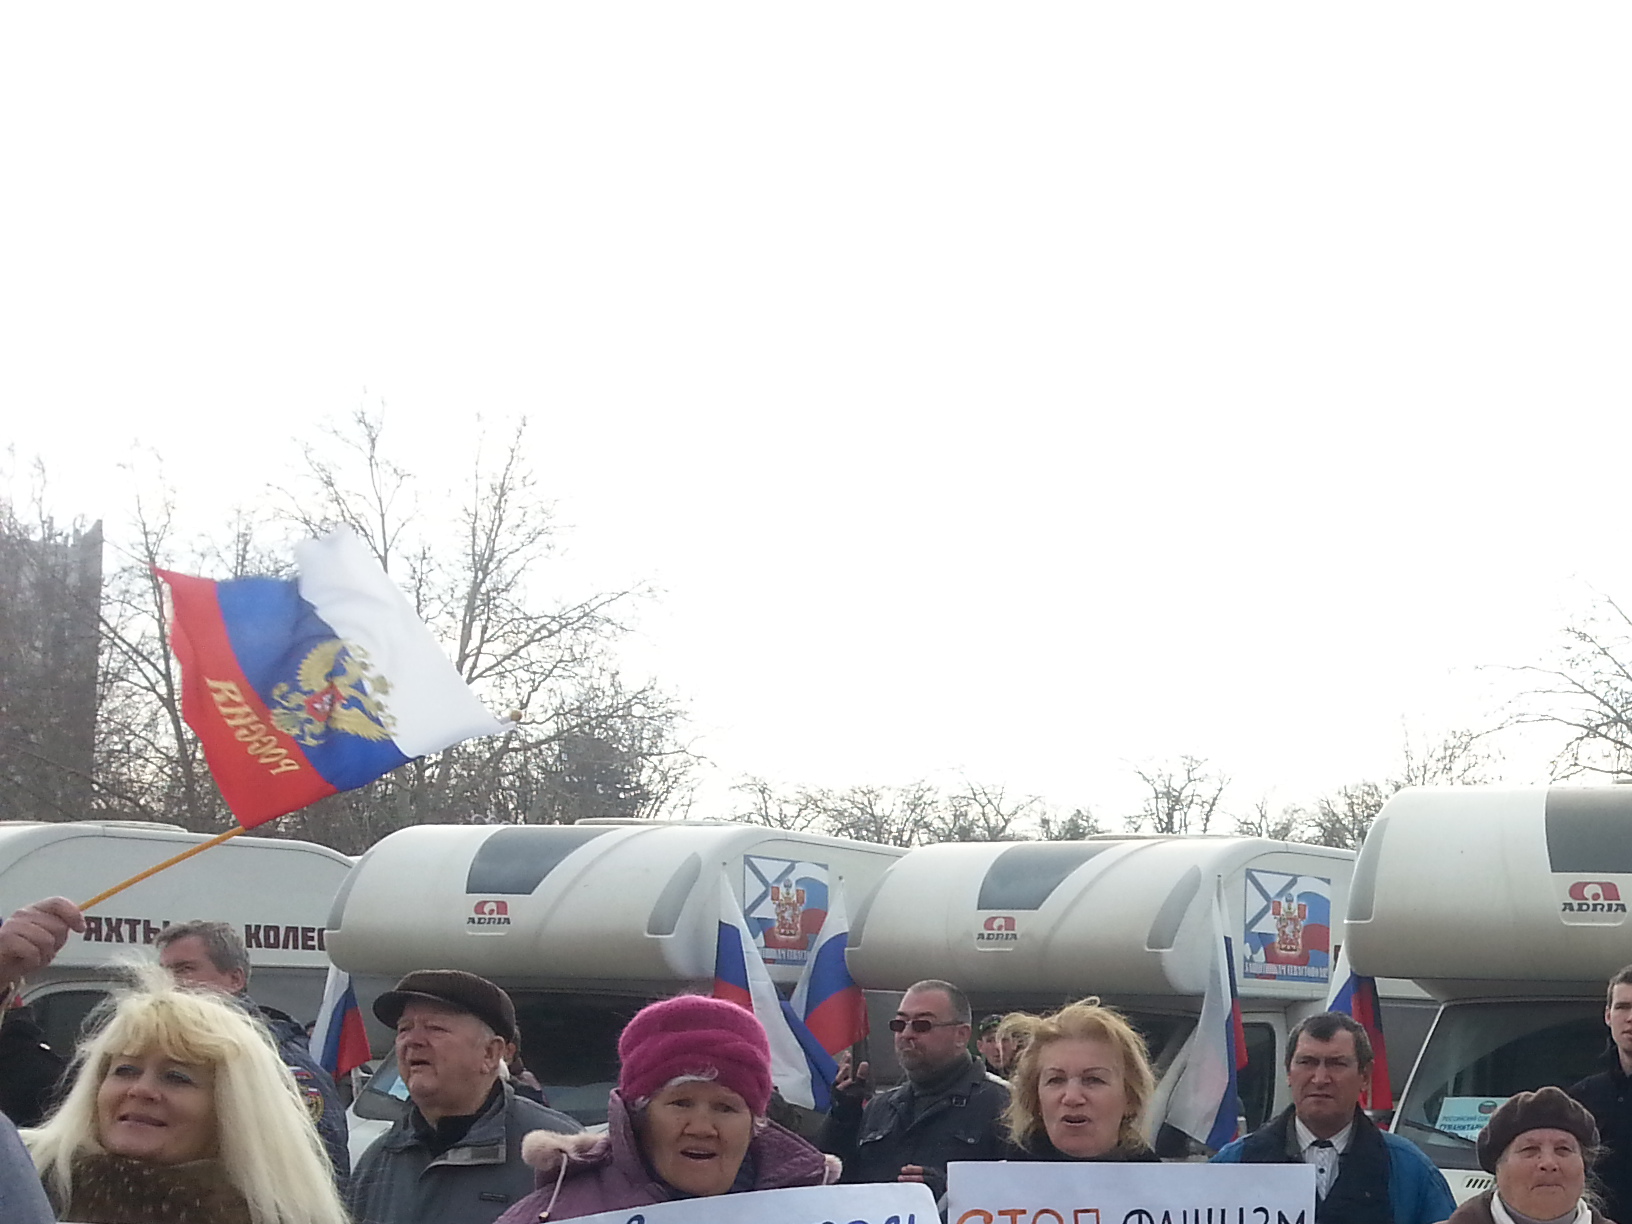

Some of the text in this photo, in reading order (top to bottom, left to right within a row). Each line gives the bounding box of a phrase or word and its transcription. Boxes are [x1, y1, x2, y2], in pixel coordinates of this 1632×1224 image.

[1561, 902, 1627, 912] ADRIA
[467, 917, 511, 925] ADRIA
[977, 933, 1018, 941] ADRIA
